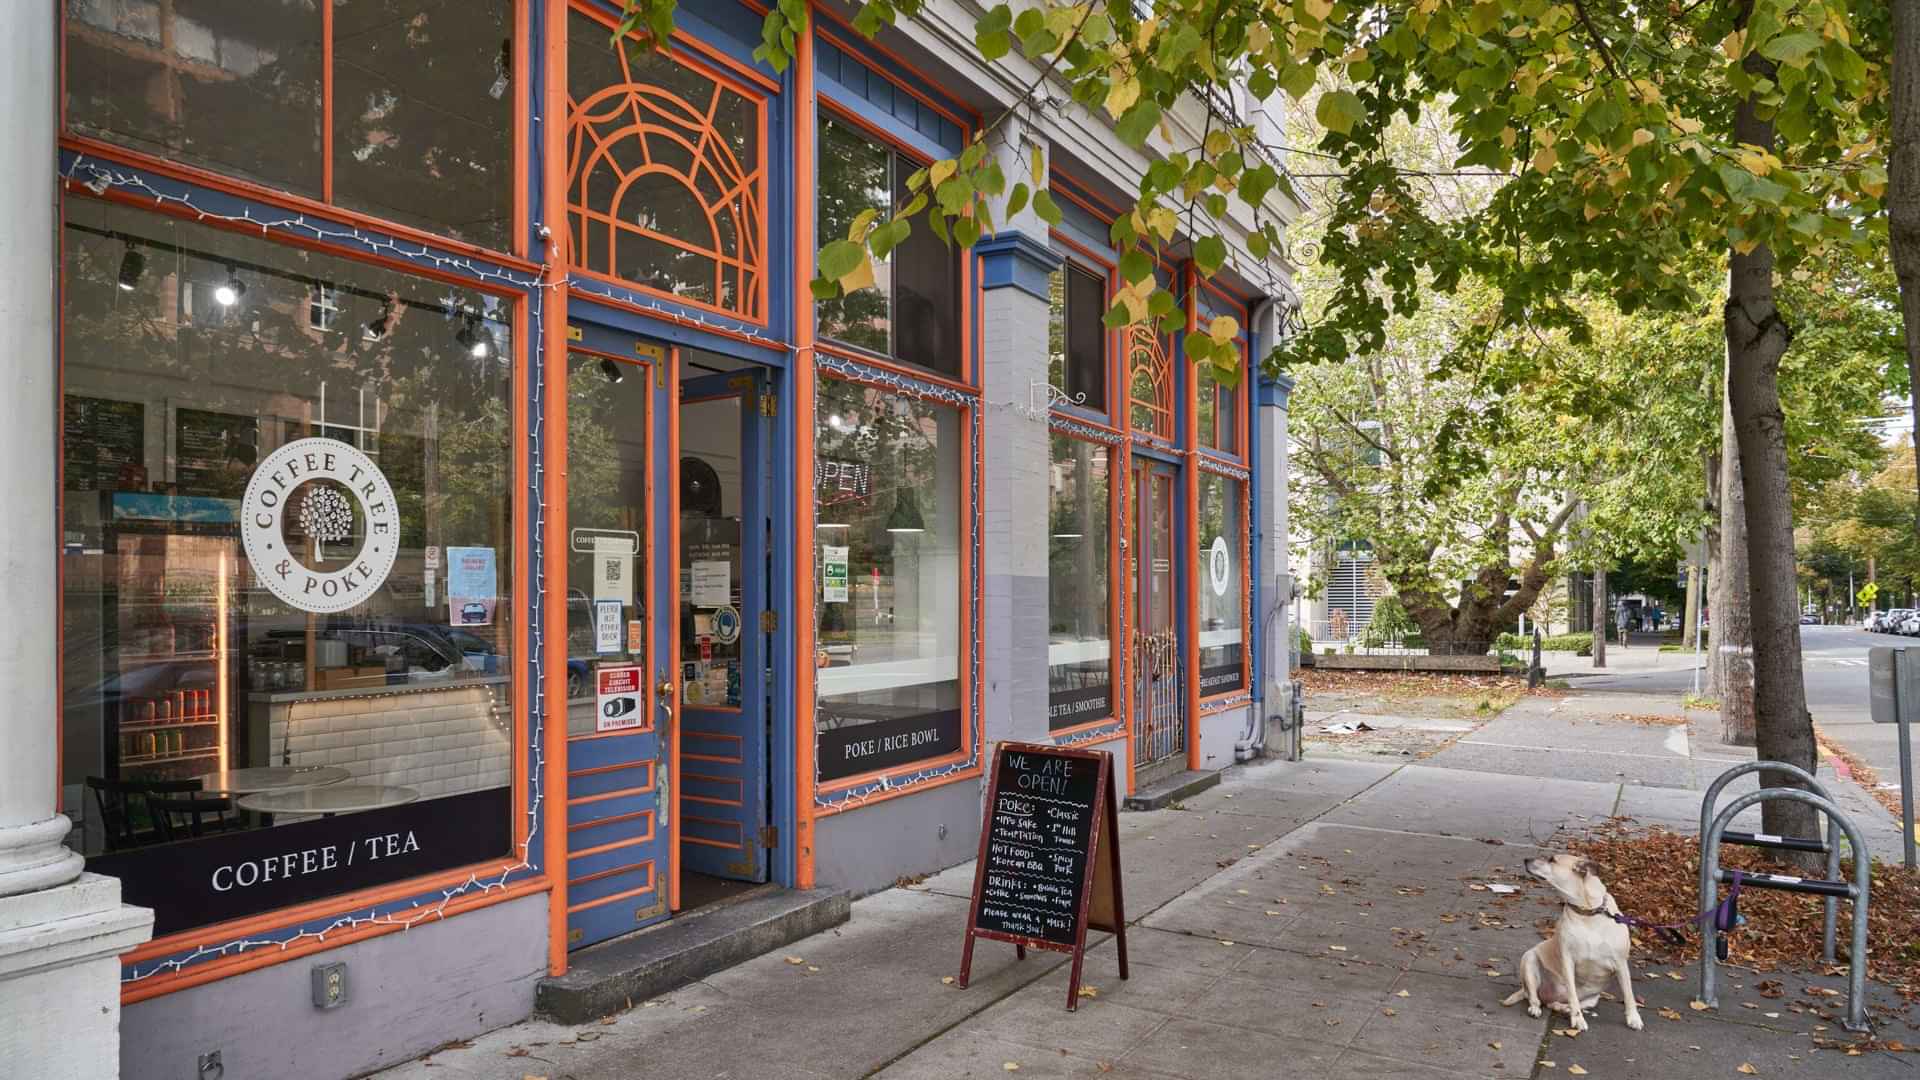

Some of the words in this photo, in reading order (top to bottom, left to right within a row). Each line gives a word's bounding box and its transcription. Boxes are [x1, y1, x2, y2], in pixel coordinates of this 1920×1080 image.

[256, 453, 336, 529] COFFEE
[348, 464, 389, 535] TREE
[275, 559, 293, 581] &
[303, 561, 374, 597] POKE
[1058, 703, 1071, 716] TEA
[845, 740, 875, 760] POKE
[884, 733, 909, 752] RICE
[911, 728, 940, 746] BOWL
[1009, 755, 1031, 770] WE
[1042, 759, 1073, 777] ARE
[1017, 774, 1068, 796] OPEN!
[211, 845, 338, 892] COFFEE
[365, 830, 421, 861] TEA
